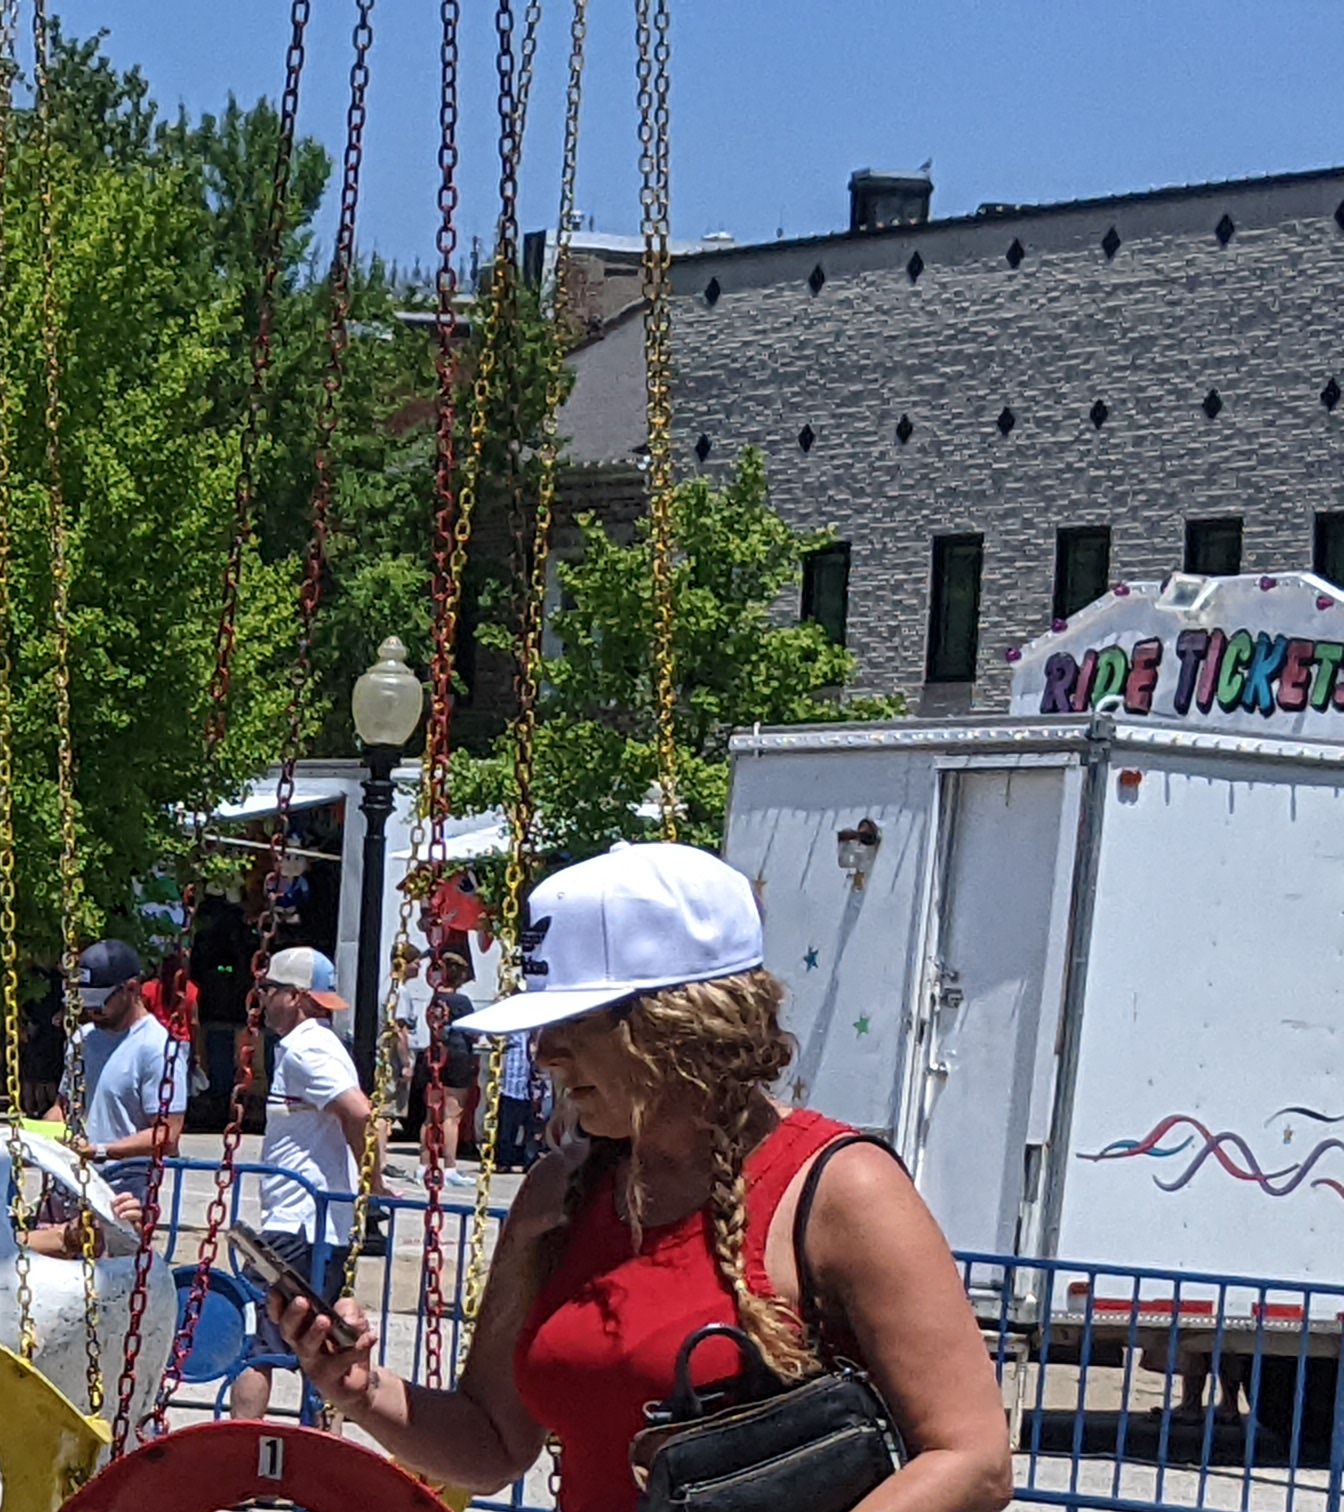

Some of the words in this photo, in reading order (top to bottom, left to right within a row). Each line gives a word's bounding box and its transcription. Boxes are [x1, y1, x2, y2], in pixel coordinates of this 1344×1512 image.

[1040, 636, 1163, 716] RIDE
[1173, 627, 1344, 718] TICKET
[265, 1439, 278, 1476] 1
